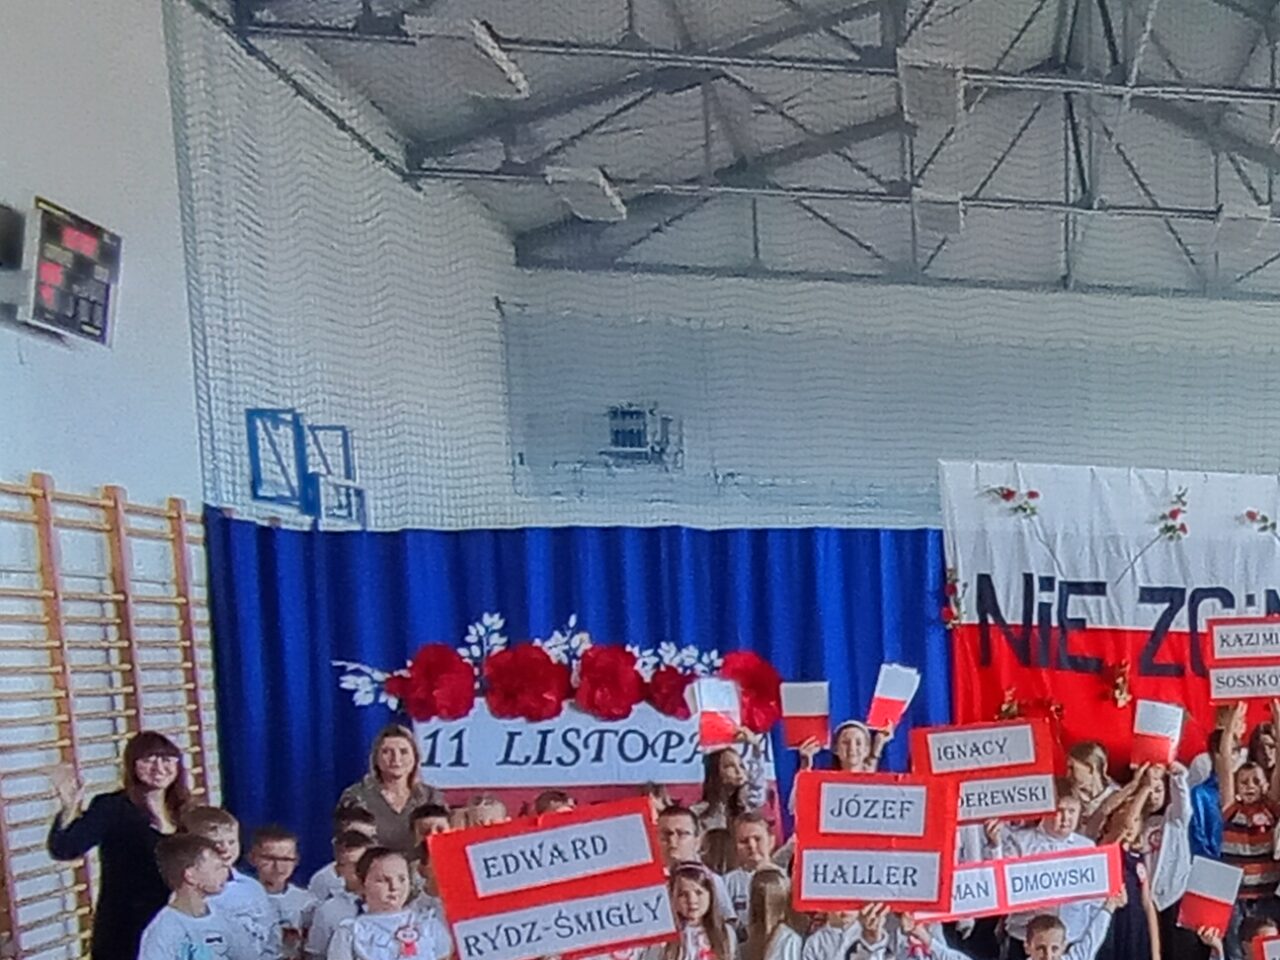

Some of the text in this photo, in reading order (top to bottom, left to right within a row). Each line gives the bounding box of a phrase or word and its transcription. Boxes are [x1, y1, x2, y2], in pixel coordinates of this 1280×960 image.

[421, 728, 470, 768] 11
[937, 737, 1008, 761] IGNACY
[829, 794, 916, 819] JÓZEF
[482, 834, 609, 879] EDWARD
[812, 863, 918, 888] HALLER
[1011, 867, 1096, 894] DMOWSKI
[463, 895, 664, 958] RYDZ-ŚMIGŁY
